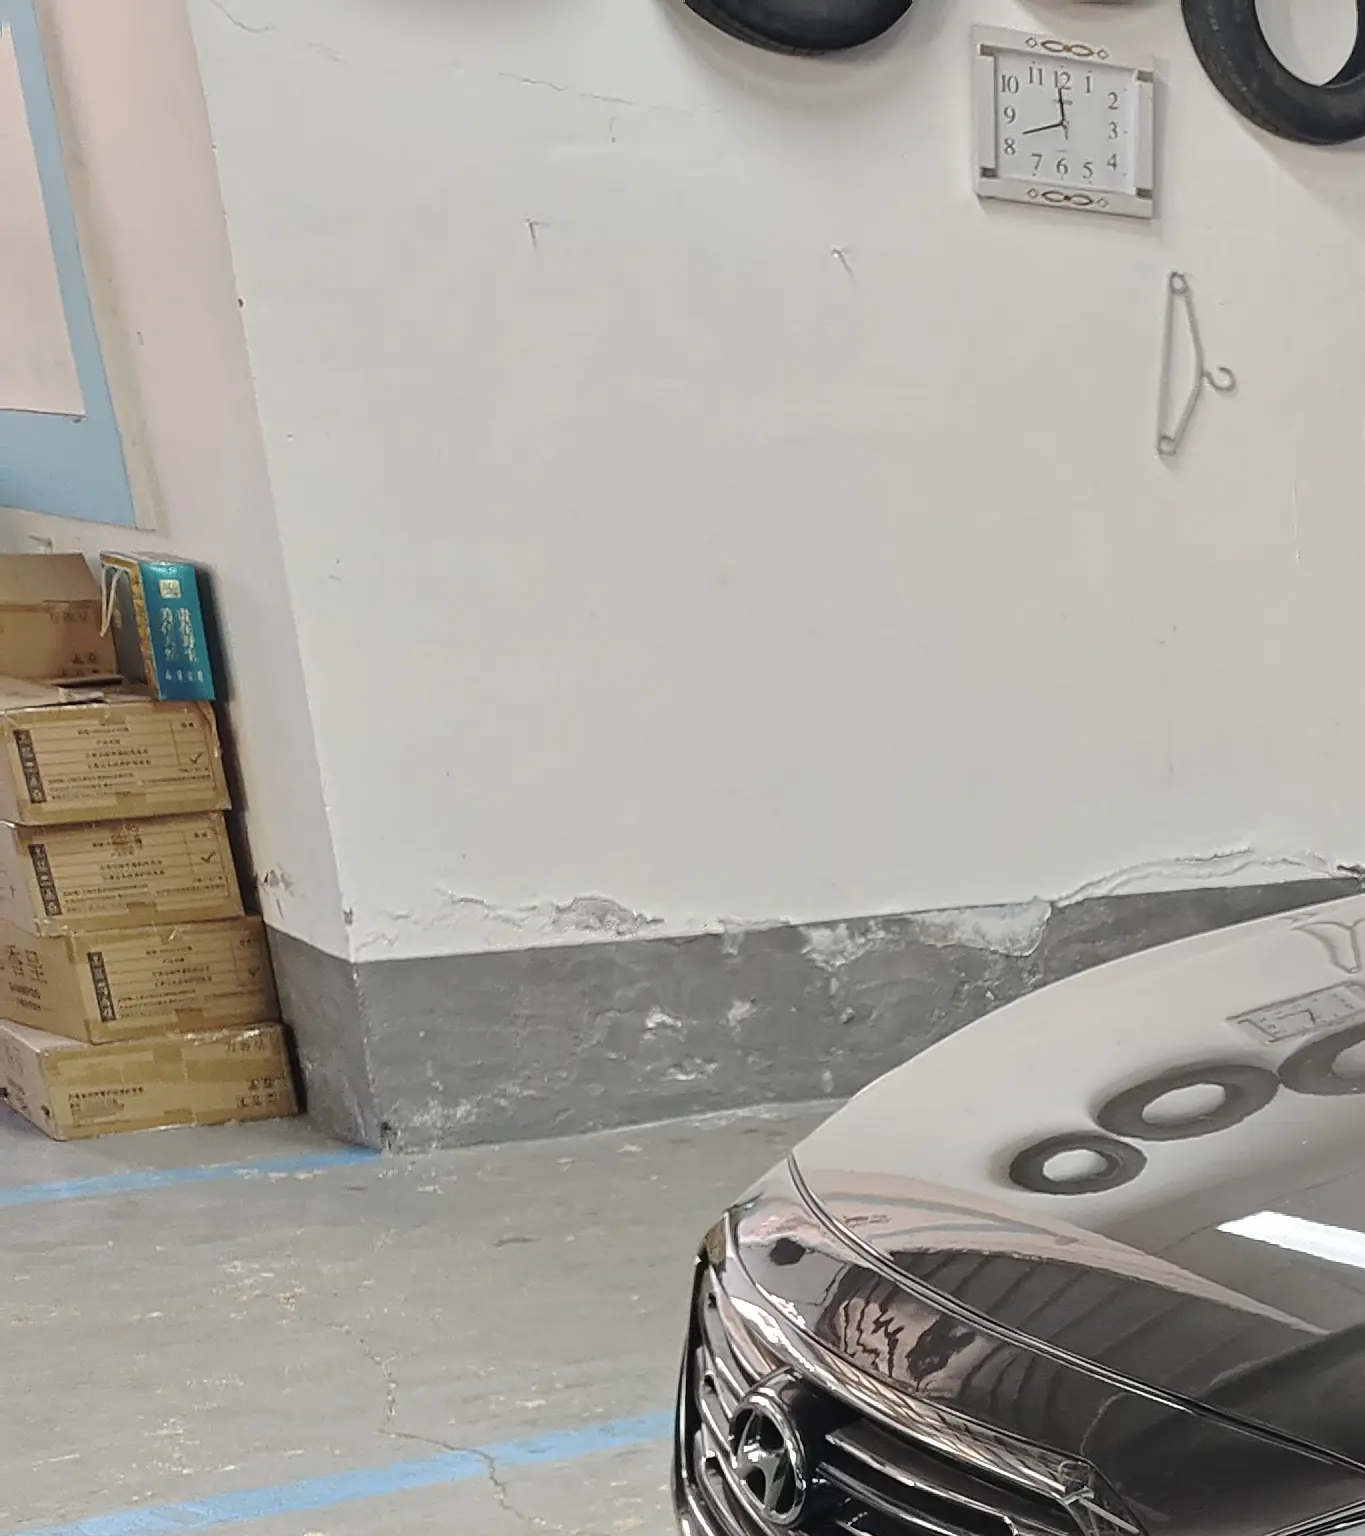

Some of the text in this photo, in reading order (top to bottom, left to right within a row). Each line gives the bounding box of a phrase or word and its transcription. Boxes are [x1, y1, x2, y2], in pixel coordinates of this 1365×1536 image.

[1001, 74, 1019, 94] 10
[1028, 66, 1044, 86] 11
[1054, 69, 1072, 90] 12
[1085, 75, 1092, 93] 1
[1107, 92, 1119, 110] 2
[1003, 105, 1016, 123] 9
[1108, 121, 1119, 140] 3
[1003, 138, 1016, 156] 8
[1031, 153, 1043, 171] 7
[1056, 157, 1069, 177] 6
[1082, 161, 1093, 179] 5
[1106, 153, 1118, 171] 4
